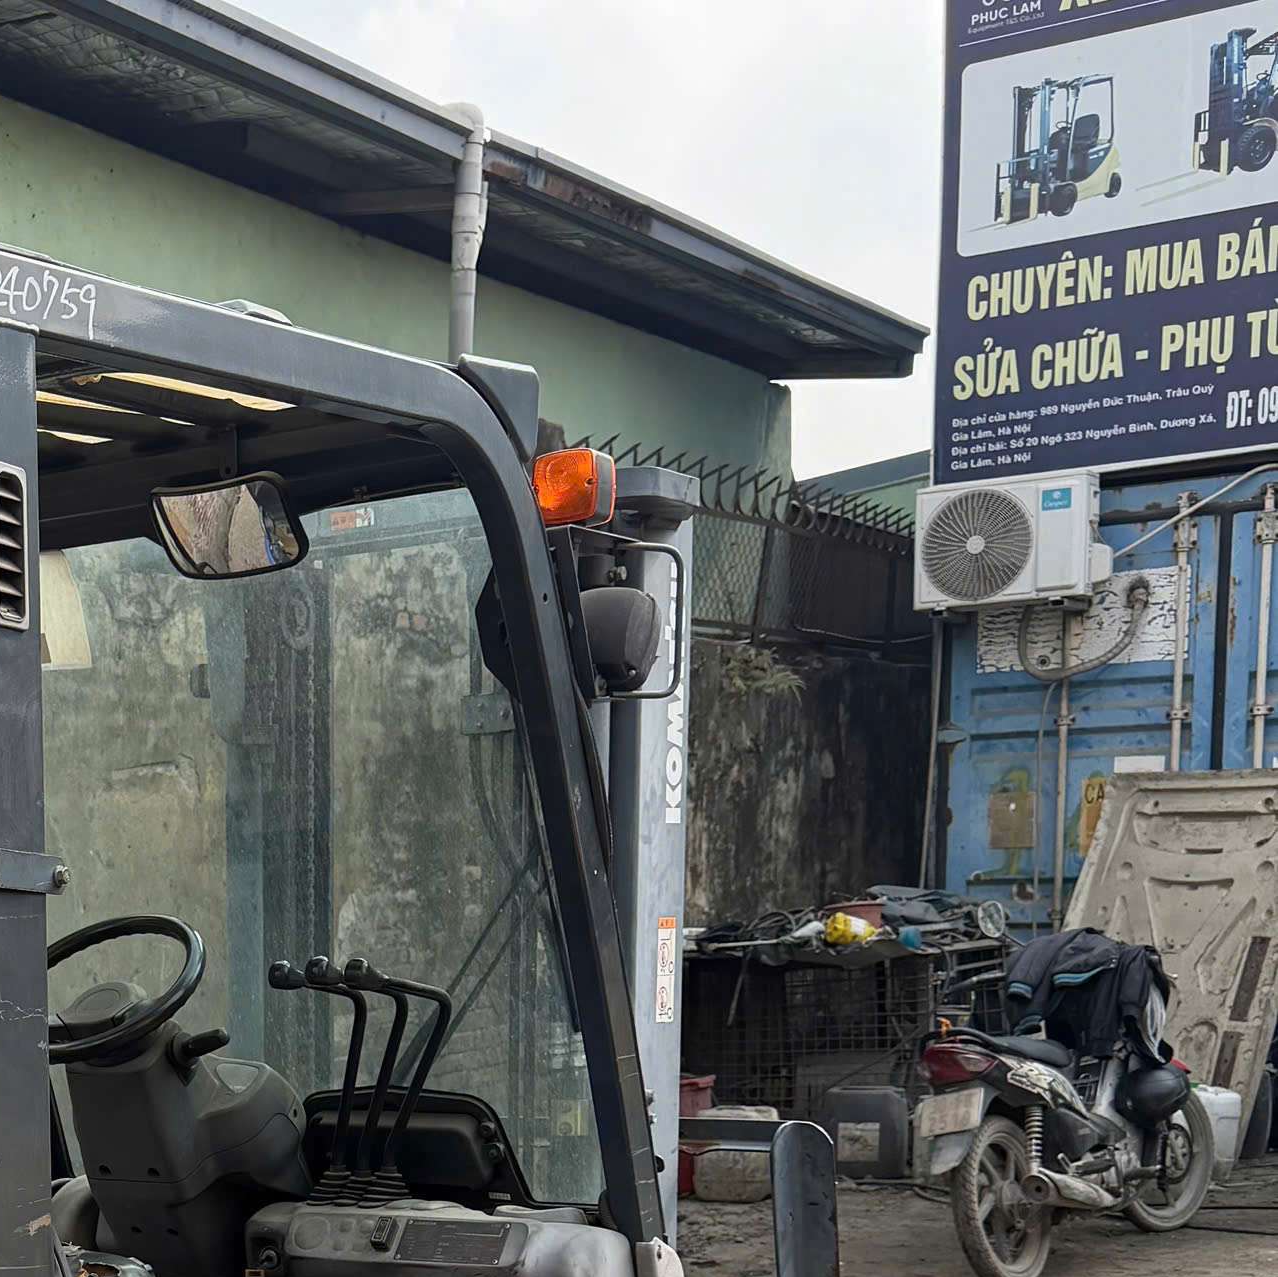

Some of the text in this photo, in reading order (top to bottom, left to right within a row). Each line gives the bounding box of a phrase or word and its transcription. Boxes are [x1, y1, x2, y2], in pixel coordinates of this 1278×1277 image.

[971, 8, 1009, 26] PHUC
[1012, 1, 1042, 16] LAM
[967, 251, 1113, 321] CHUYÊN:
[1124, 238, 1204, 296] MUA
[953, 337, 1020, 401] SỬA
[1030, 327, 1124, 390] CHỮA
[1160, 315, 1235, 374] PHỤ
[952, 417, 969, 428] Địa
[1226, 389, 1253, 429] ĐT:
[951, 446, 968, 457] Địa
[1009, 436, 1024, 449] Số
[1025, 437, 1039, 447] 20
[1064, 431, 1083, 442] 323
[1085, 424, 1126, 440] Nguyễn
[952, 432, 969, 442] Gia
[997, 425, 1012, 436] Hà
[1013, 423, 1031, 434] Nội
[950, 460, 969, 471] Gia
[997, 454, 1012, 465] Hà
[1013, 451, 1032, 463] Nội
